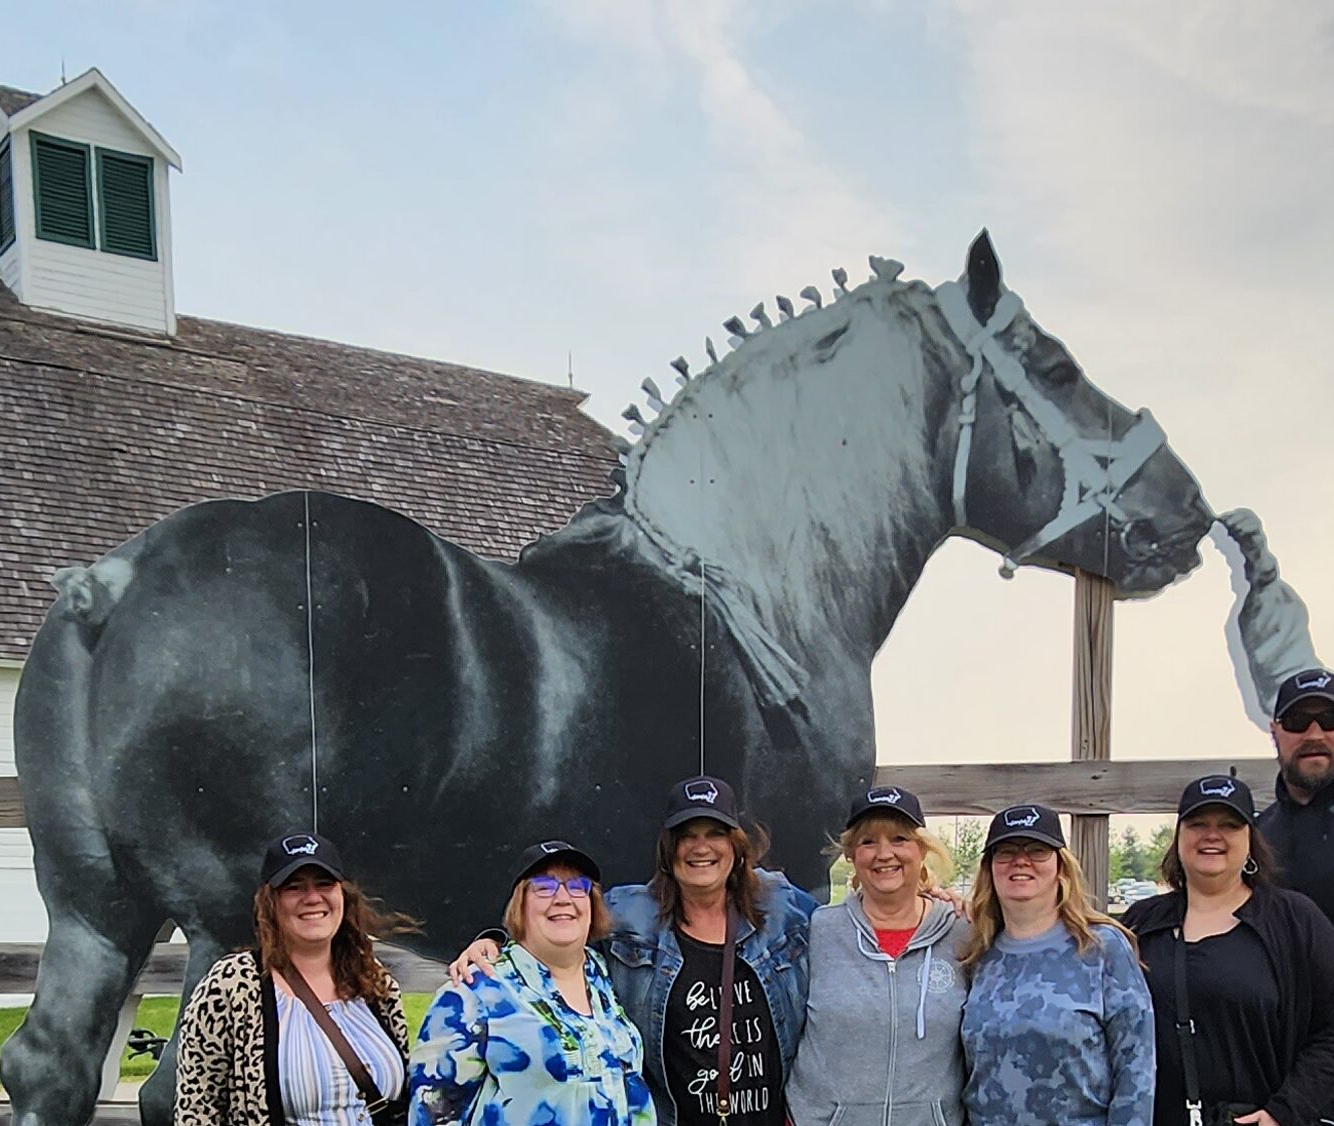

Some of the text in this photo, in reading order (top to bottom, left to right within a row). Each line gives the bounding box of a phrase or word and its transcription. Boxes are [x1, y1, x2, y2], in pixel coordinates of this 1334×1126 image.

[680, 1016, 763, 1049] theE IS
[687, 1051, 764, 1095] god IN
[728, 1086, 769, 1115] WORLD
